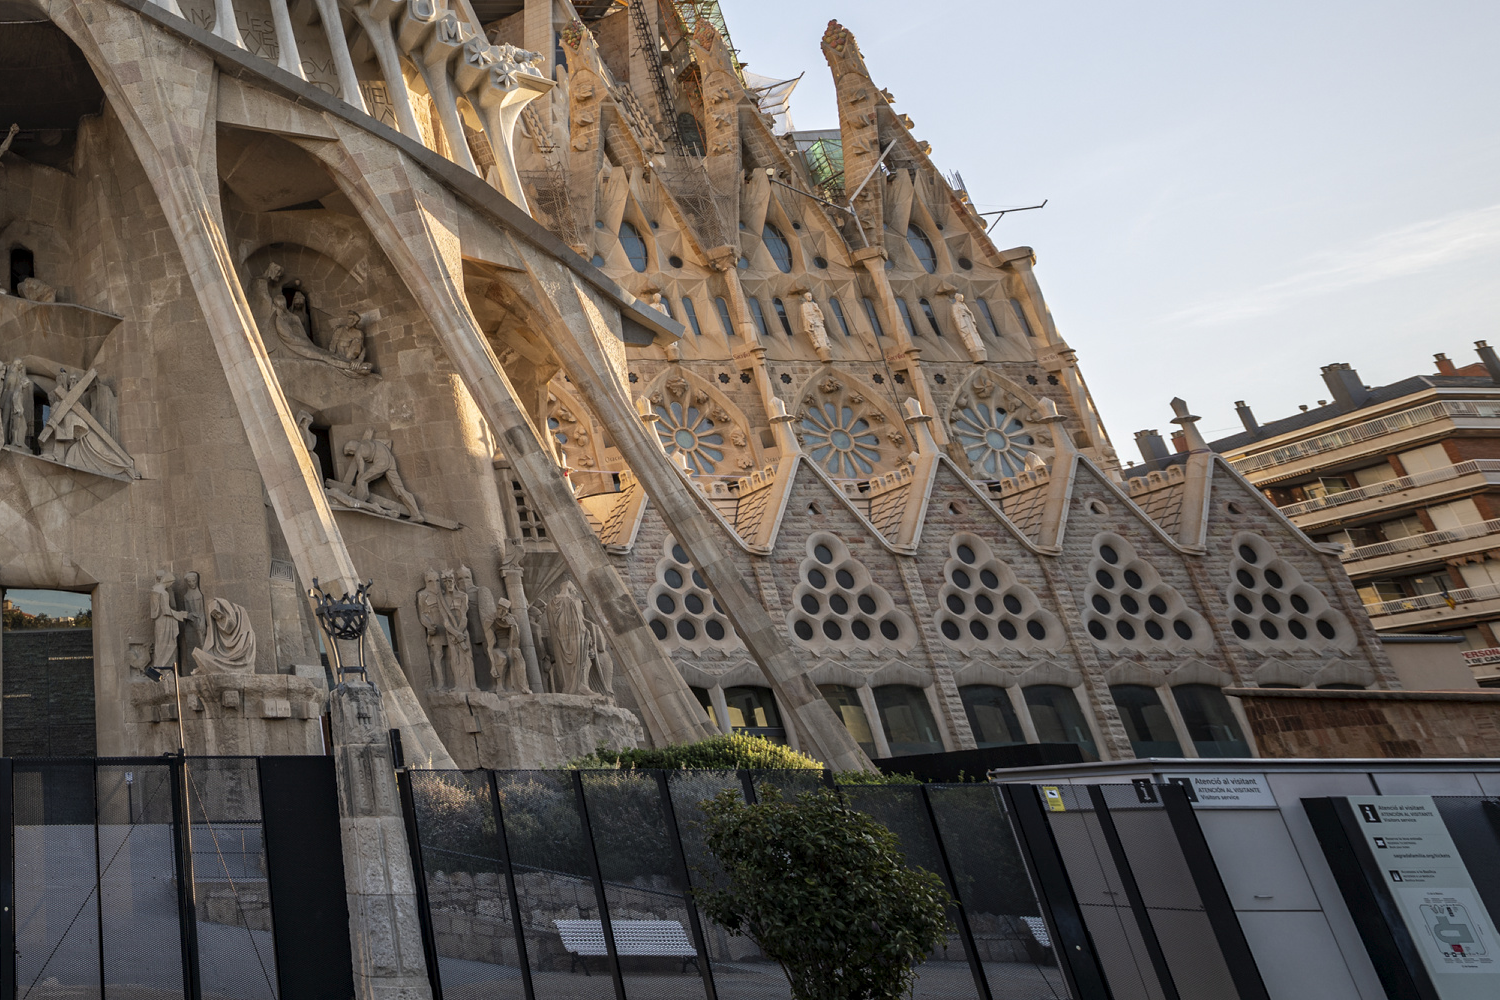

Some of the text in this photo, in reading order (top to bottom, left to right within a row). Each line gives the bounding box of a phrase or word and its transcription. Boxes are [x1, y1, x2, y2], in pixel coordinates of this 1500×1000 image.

[1194, 777, 1257, 785] Atenció al visitant
